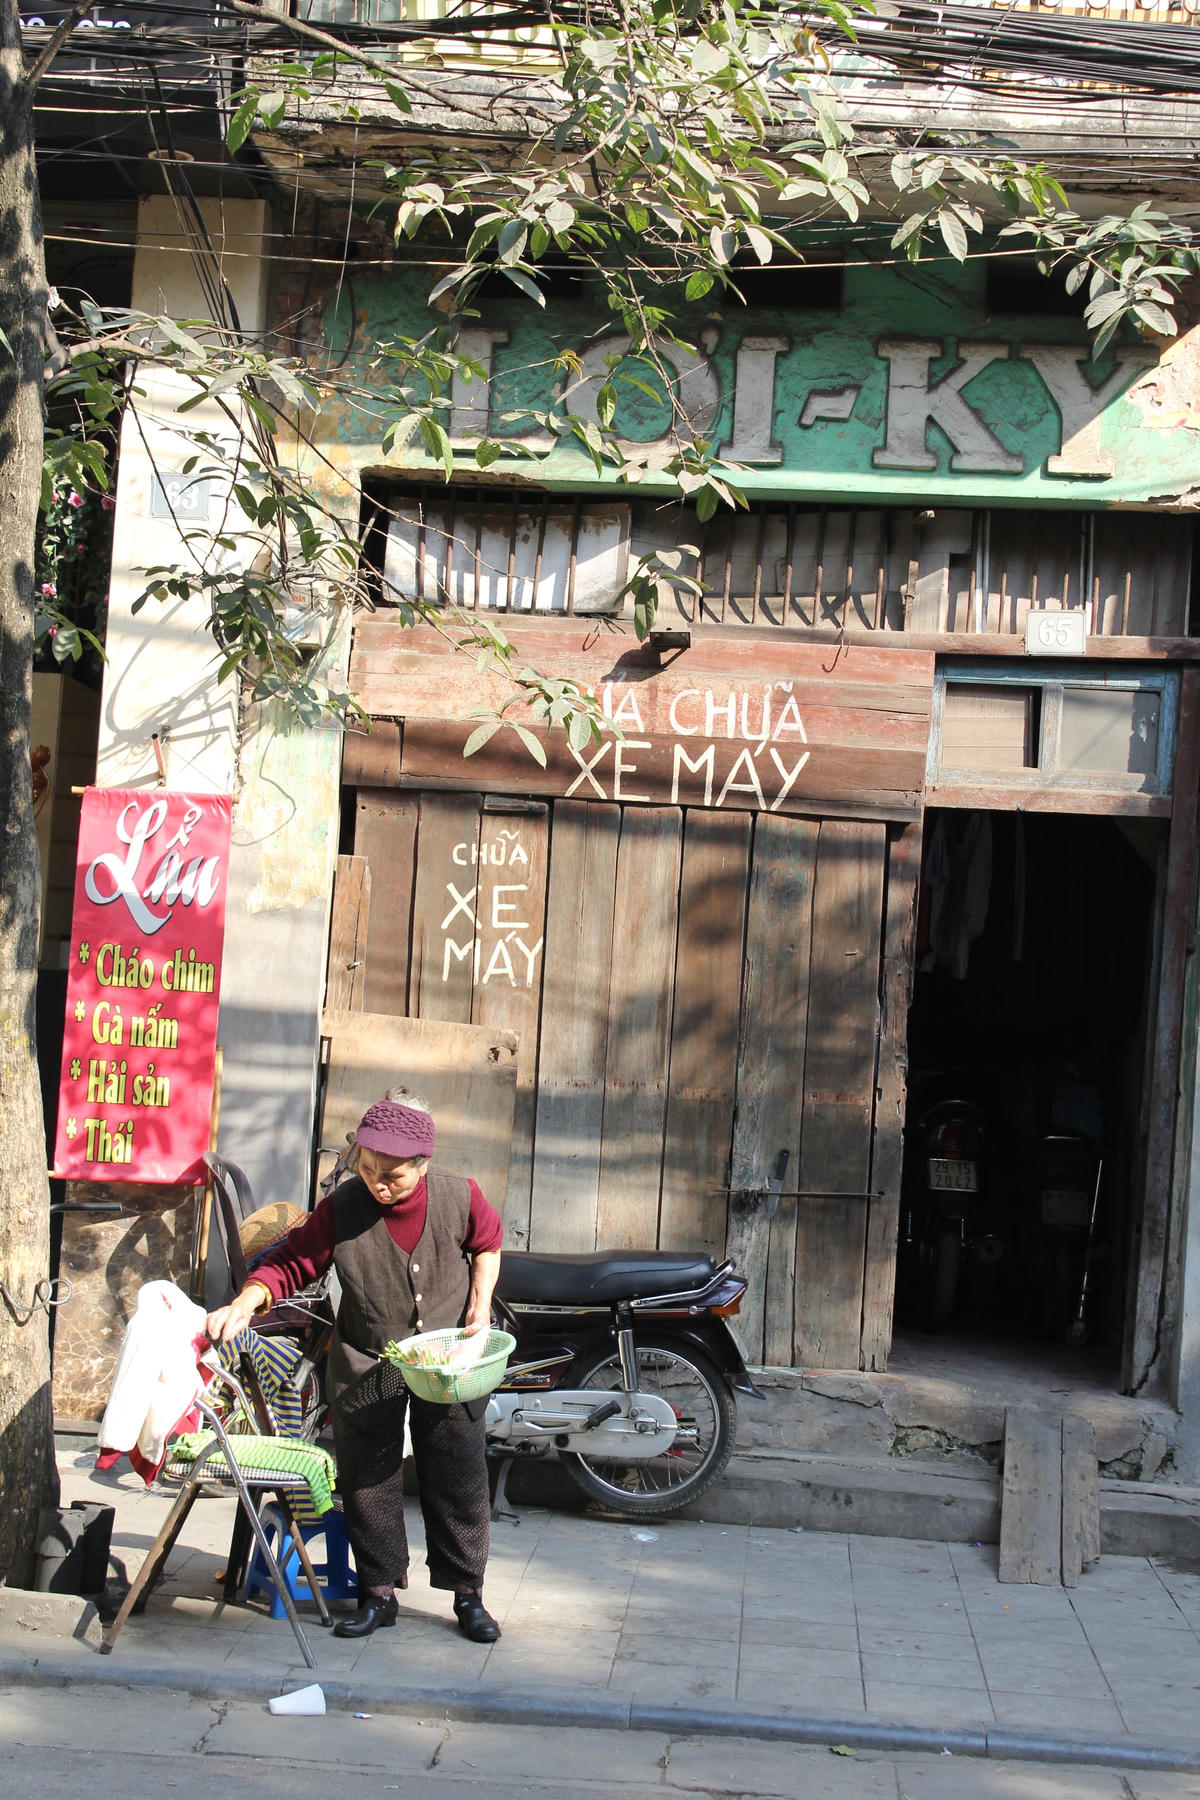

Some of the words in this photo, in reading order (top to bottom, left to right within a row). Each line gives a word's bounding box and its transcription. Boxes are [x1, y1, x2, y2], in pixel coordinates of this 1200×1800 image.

[165, 481, 200, 510] 63
[1038, 617, 1073, 647] 65
[564, 740, 652, 801] XE
[671, 740, 811, 811] MÁY
[85, 800, 220, 934] Lẩu
[441, 882, 530, 930] XE
[96, 942, 154, 989] Cháo
[161, 948, 215, 993] chim
[442, 930, 544, 988] MÁY
[91, 1001, 123, 1045] Gà
[129, 1003, 179, 1049] nấm
[86, 1059, 127, 1104] Hải
[132, 1063, 170, 1107] sản
[84, 1118, 134, 1164] Thái
